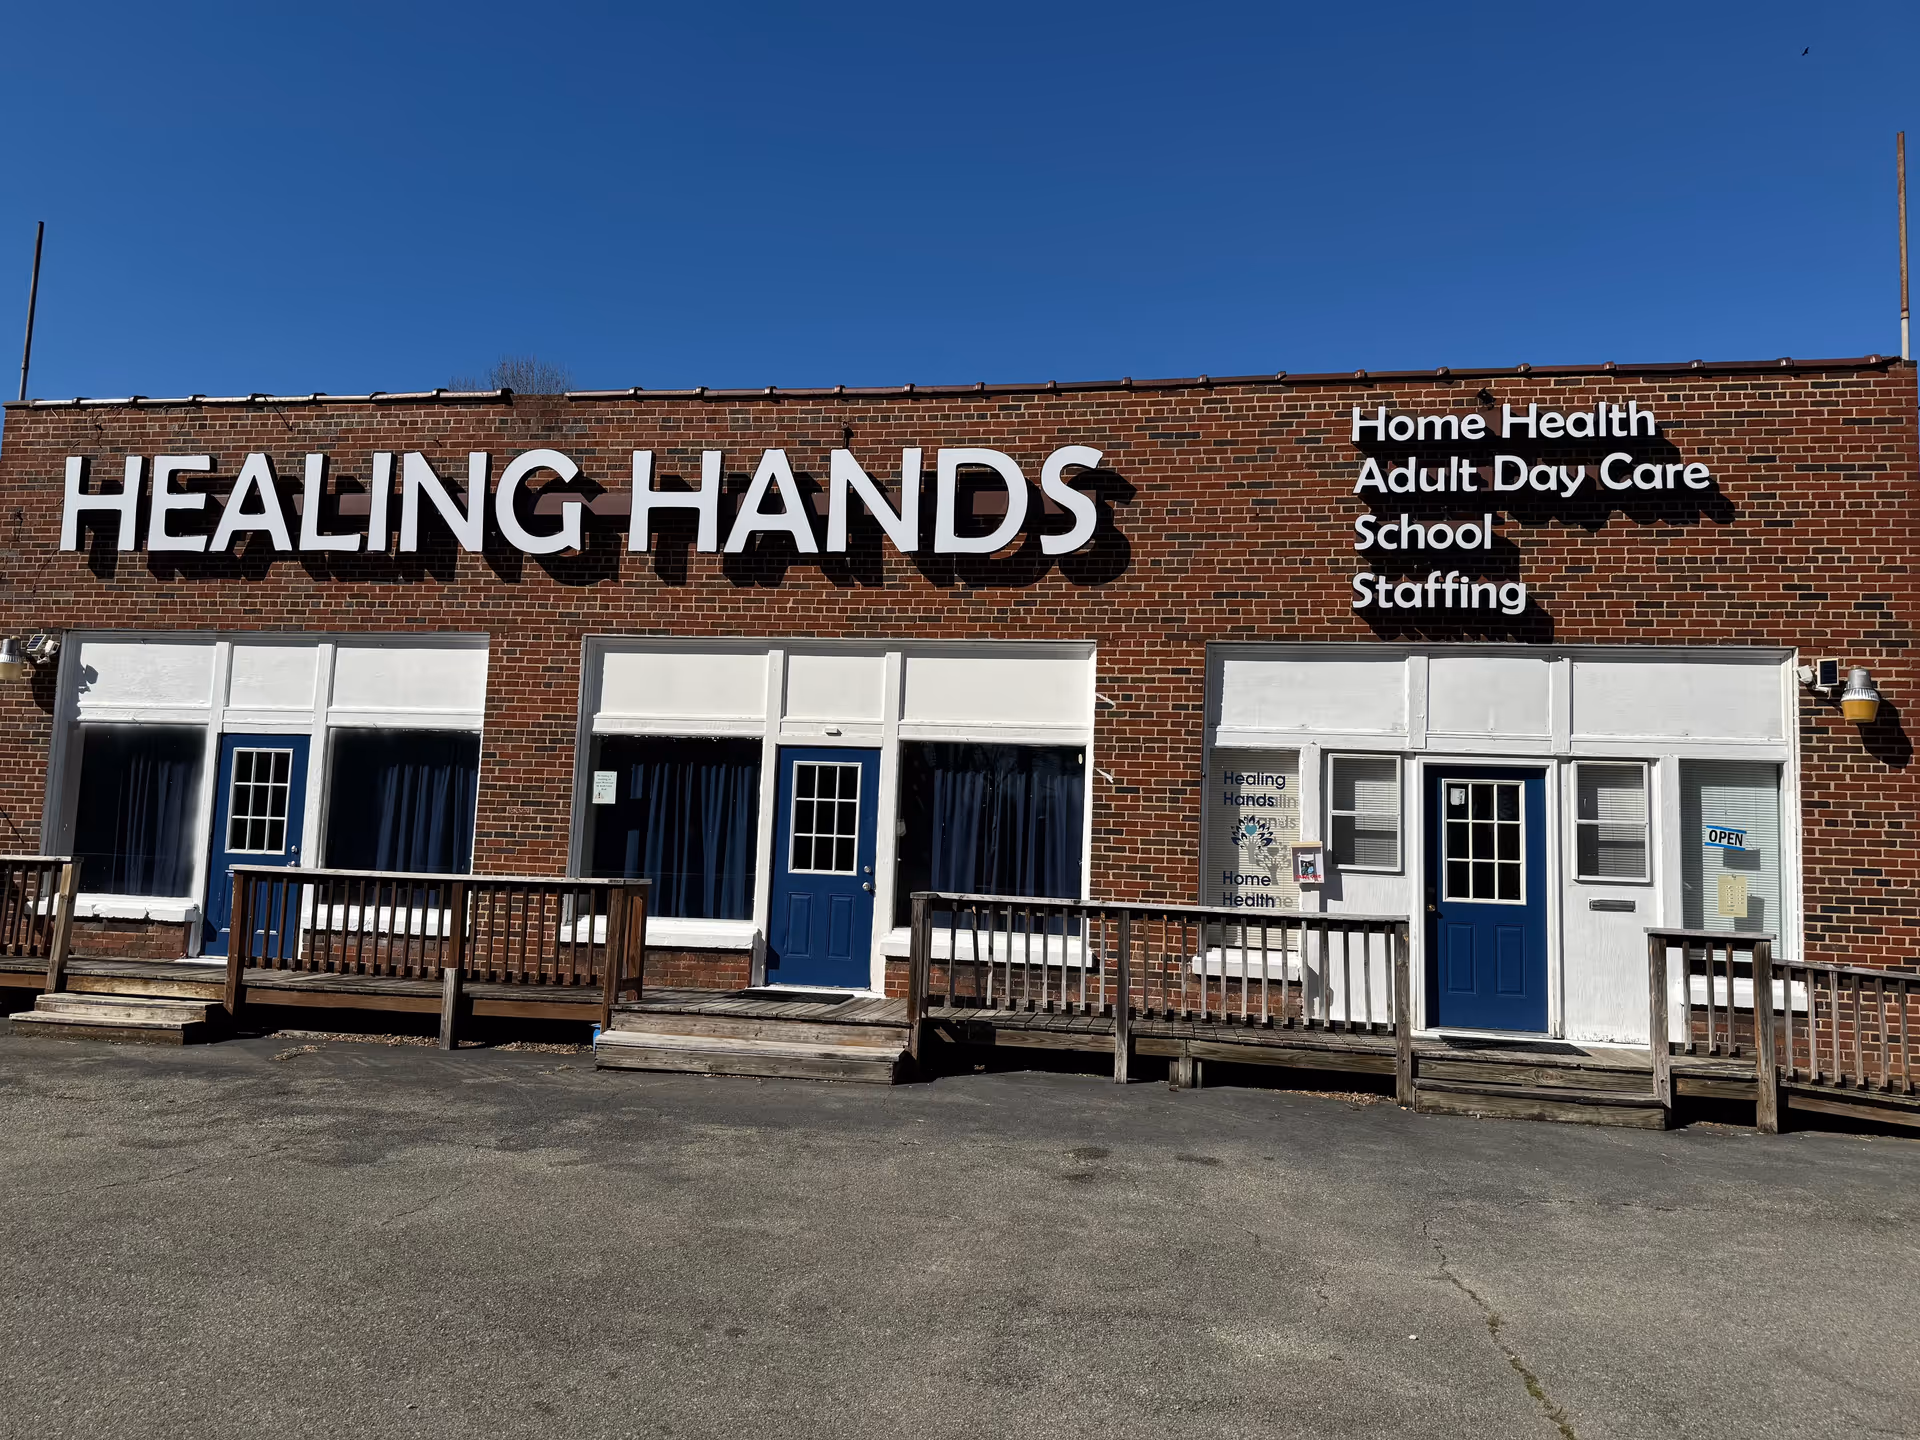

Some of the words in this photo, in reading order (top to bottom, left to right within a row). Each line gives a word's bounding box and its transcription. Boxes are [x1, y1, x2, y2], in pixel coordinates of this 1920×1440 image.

[1351, 405, 1486, 442] Home
[1501, 400, 1656, 439] Health
[1352, 455, 1478, 494] Adult
[1493, 454, 1586, 498] Day
[1600, 452, 1710, 491] Care
[59, 447, 583, 554] HEALING
[627, 445, 1104, 555] HANDS
[1353, 513, 1493, 551] School
[1352, 570, 1527, 615] Staffing
[1223, 771, 1286, 789] Healing
[1223, 792, 1275, 807] Hands
[1708, 829, 1743, 846] OPEN
[1222, 871, 1271, 887] Home
[1222, 892, 1275, 908] Health
